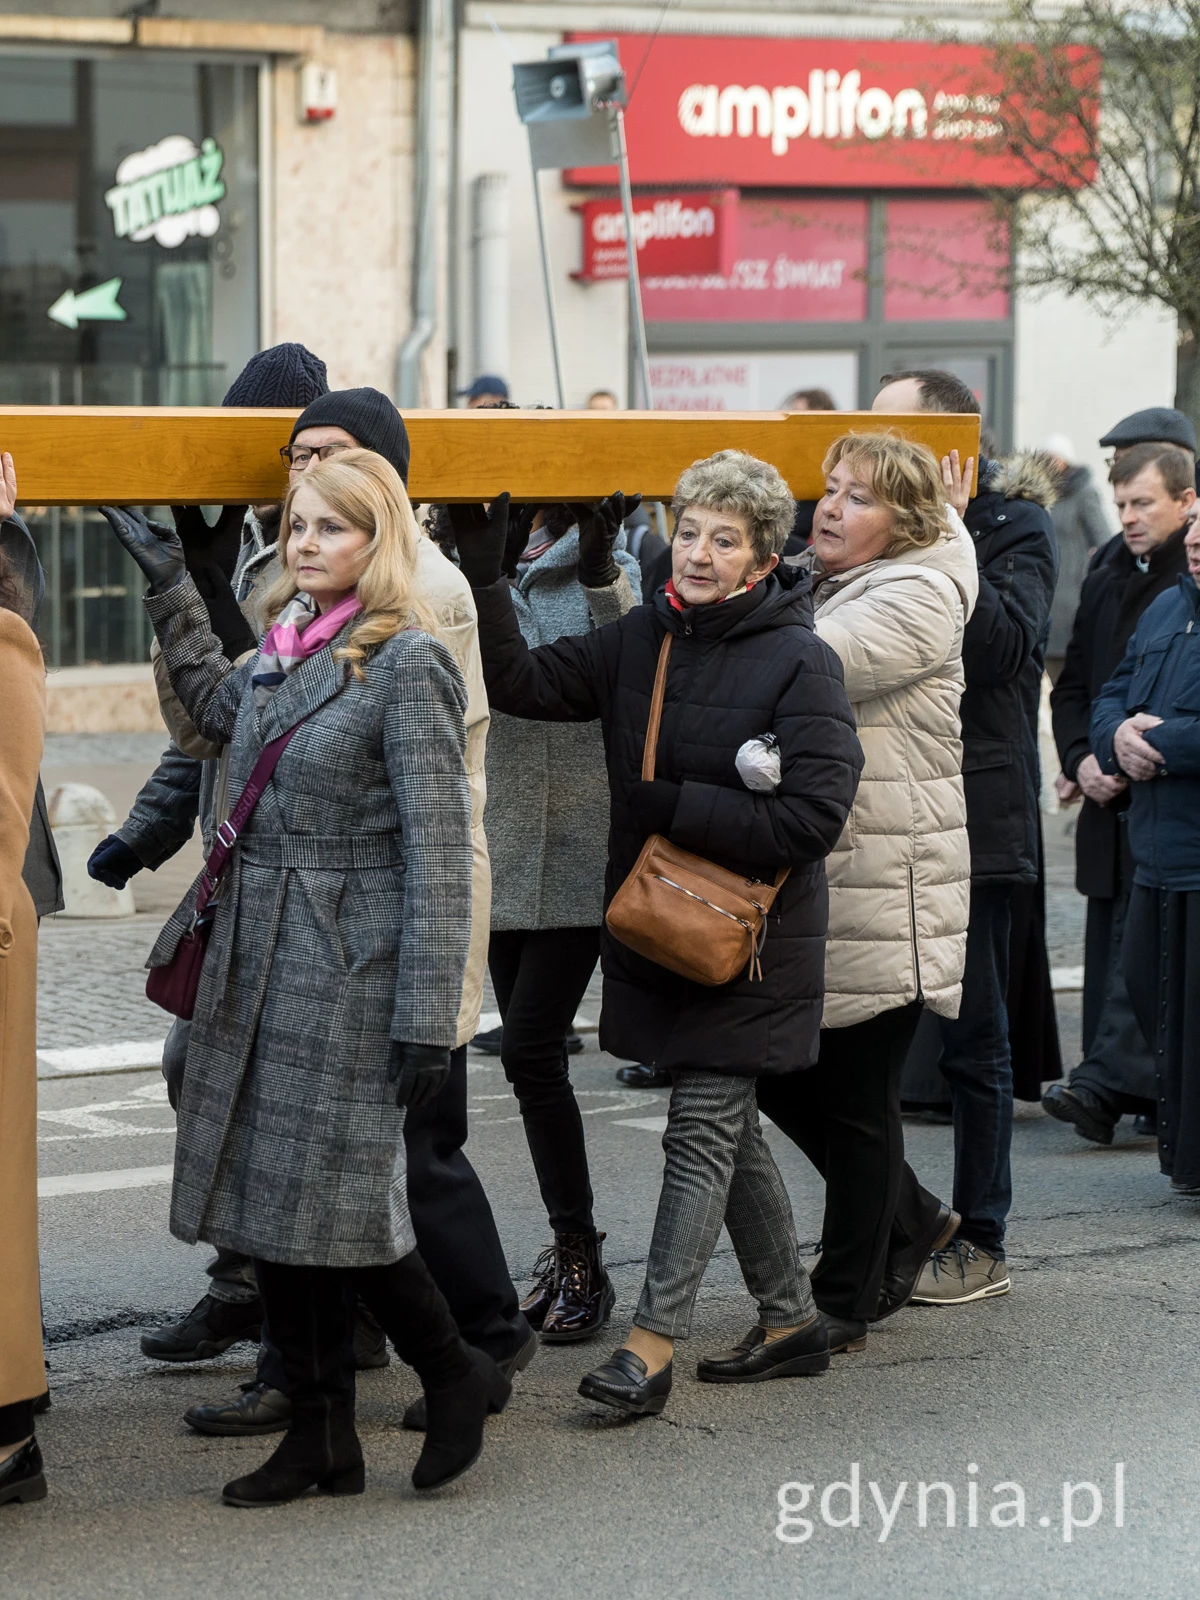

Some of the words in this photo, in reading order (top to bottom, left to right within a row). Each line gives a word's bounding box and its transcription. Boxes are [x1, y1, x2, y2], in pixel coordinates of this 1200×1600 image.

[679, 69, 928, 156] amplifon
[104, 137, 226, 239] TATUAŻ
[592, 199, 715, 250] amplifon
